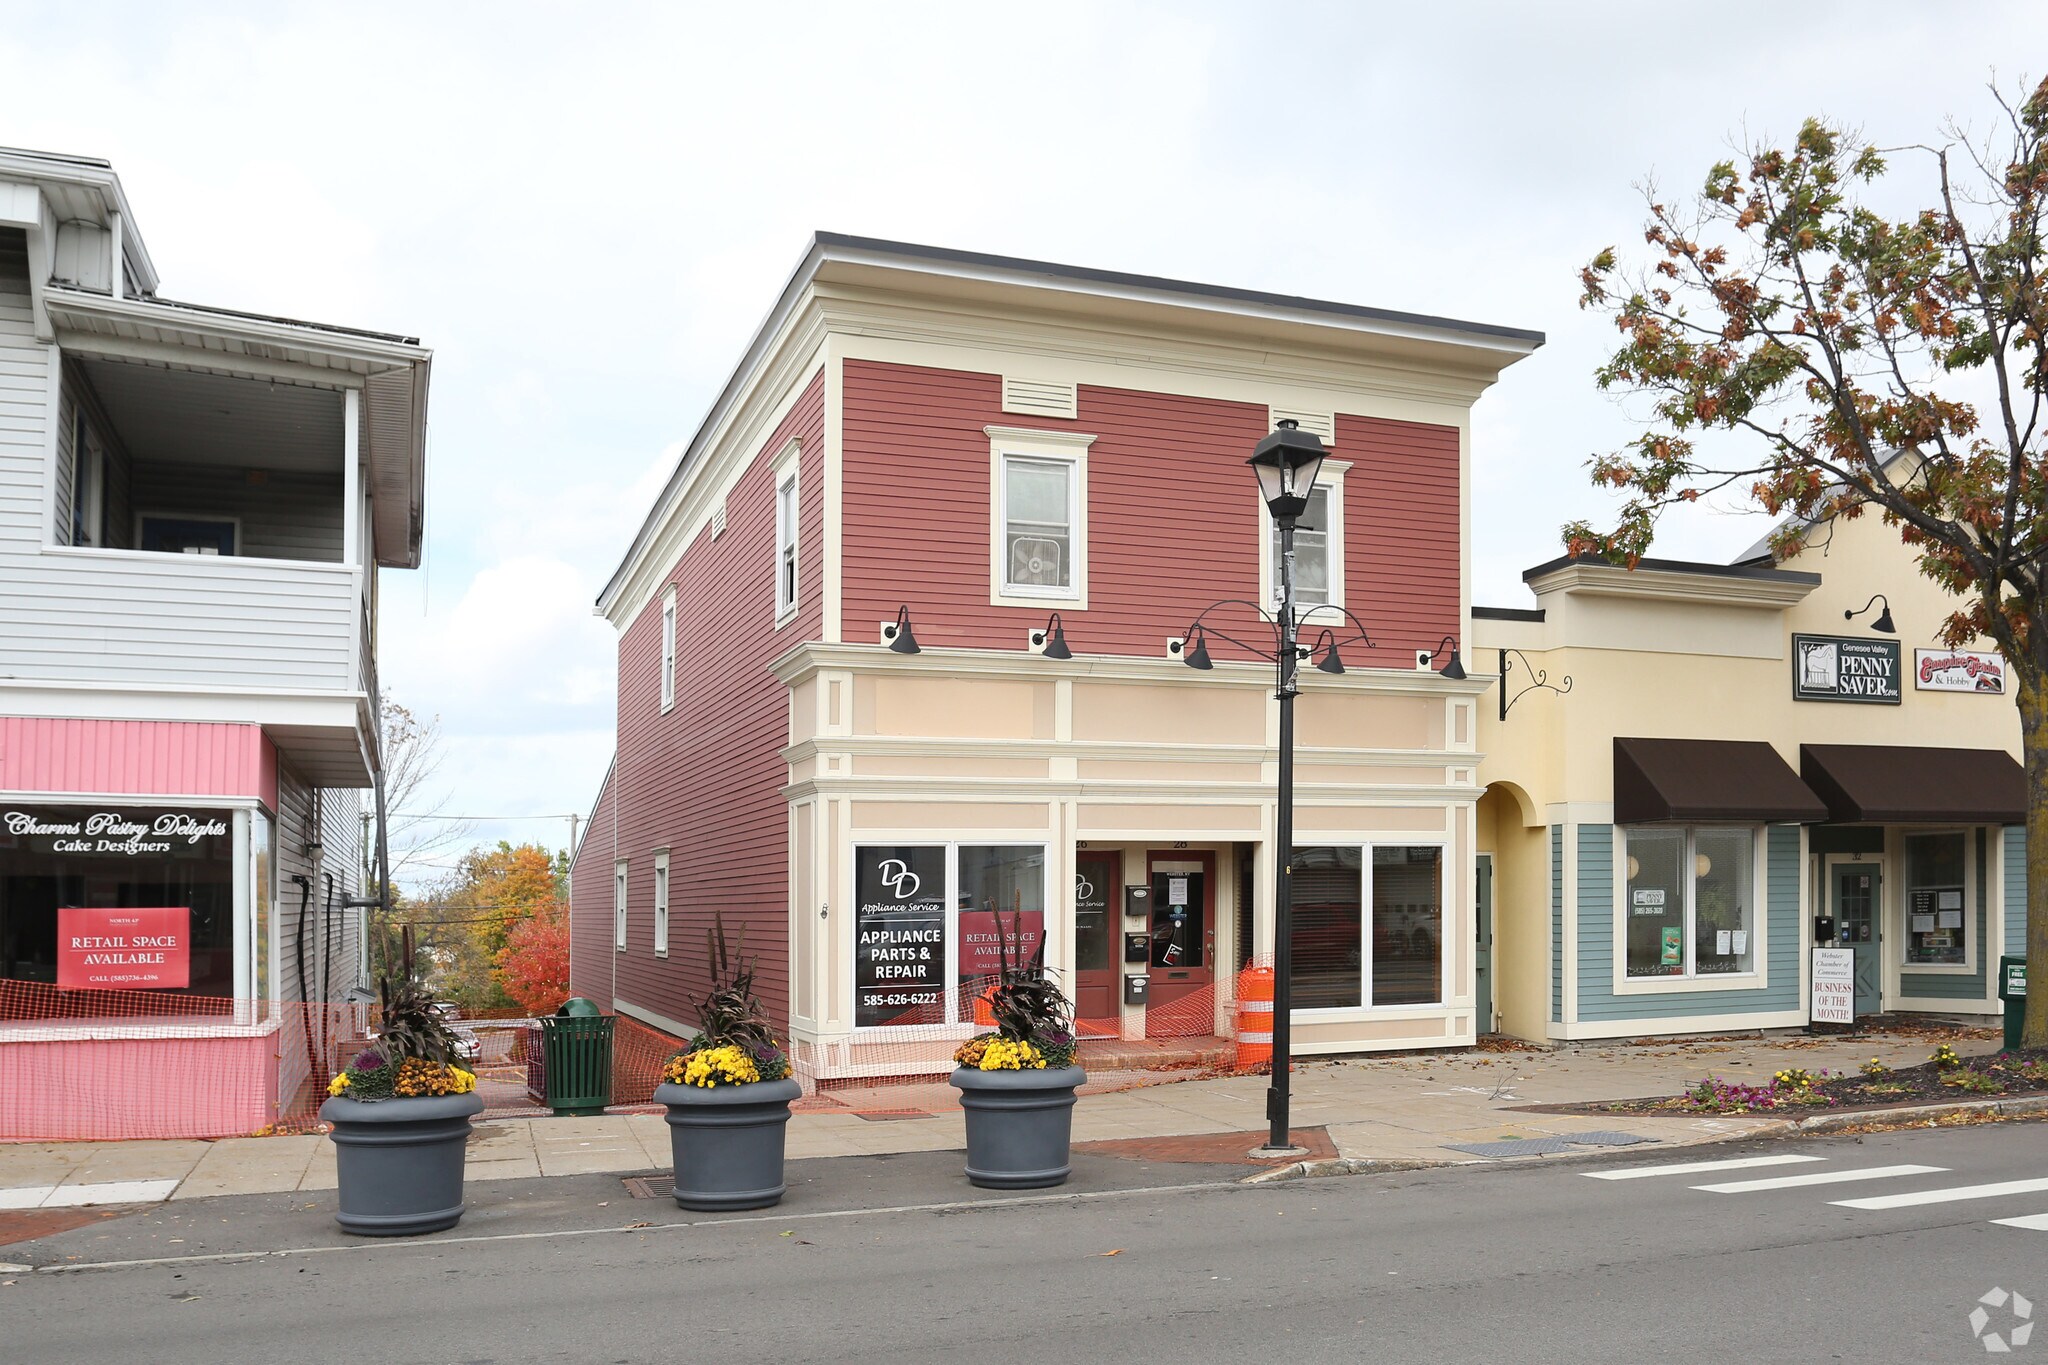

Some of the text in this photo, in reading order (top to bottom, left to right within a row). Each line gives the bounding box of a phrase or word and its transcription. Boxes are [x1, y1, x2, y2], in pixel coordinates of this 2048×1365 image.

[1871, 645, 1889, 656] Valley
[1840, 655, 1893, 676] PENNY
[1920, 653, 2002, 683] Empire Train
[1935, 673, 1970, 687] & Hobby
[4, 811, 226, 844] Charms Pastry Delights
[53, 839, 170, 855] Cake Designers
[861, 902, 940, 914] Appliance Service
[72, 936, 176, 948] RETAIL SPACE
[860, 930, 941, 944] APPLIANCE
[84, 953, 164, 965] AVAILABLE
[871, 947, 931, 961] PARTS &
[1821, 952, 1844, 960] Webster
[1816, 960, 1850, 970] Chamber of
[875, 965, 927, 979] REPAIR
[1818, 969, 1848, 977] Commerce
[1814, 982, 1852, 994] BUSINESS
[863, 993, 937, 1006] 585-626-6222
[1818, 995, 1848, 1007] OF THE
[1817, 1008, 1849, 1020] MONTH!
